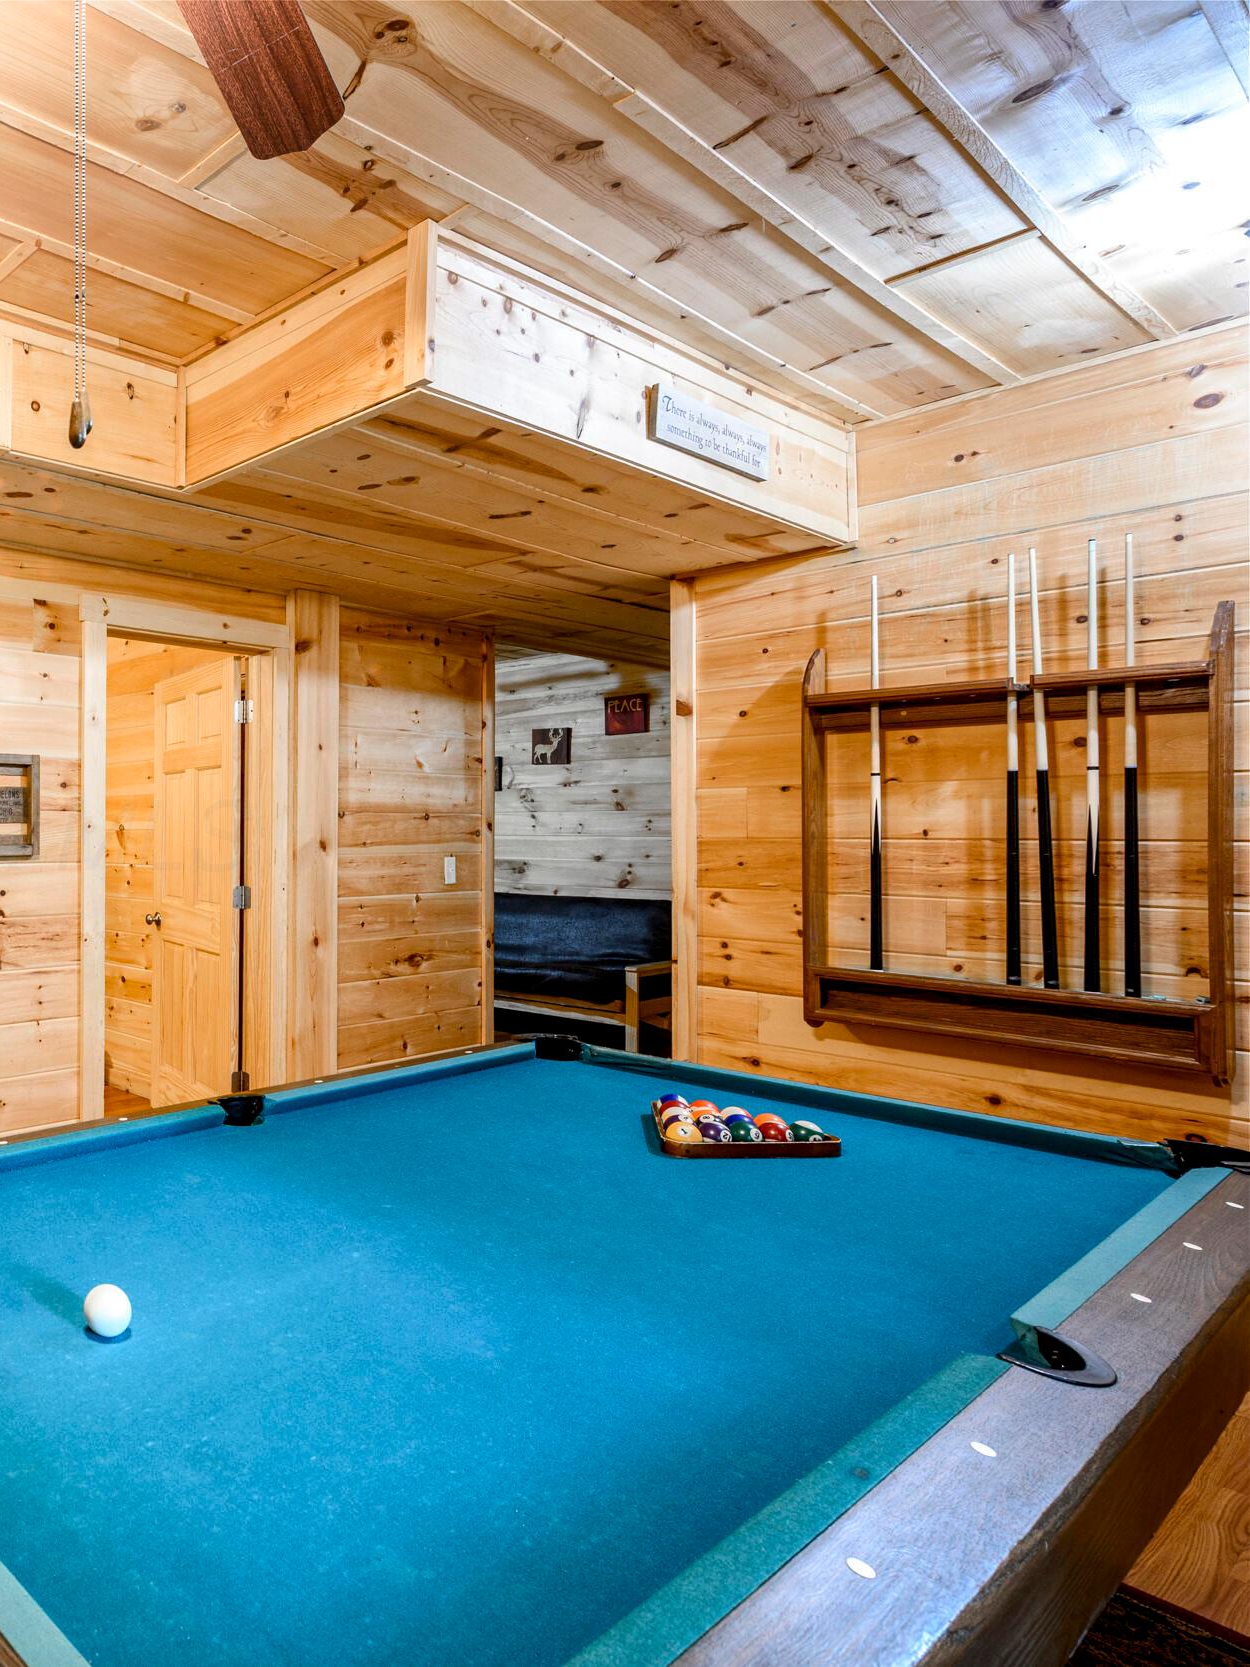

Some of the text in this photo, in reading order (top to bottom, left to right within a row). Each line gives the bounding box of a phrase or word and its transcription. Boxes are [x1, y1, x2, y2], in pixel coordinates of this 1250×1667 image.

[662, 395, 687, 419] There
[688, 410, 695, 422] is
[696, 413, 721, 434] always,
[746, 435, 767, 456] always
[666, 423, 761, 468] something to be thankful for
[607, 698, 643, 714] PEACE
